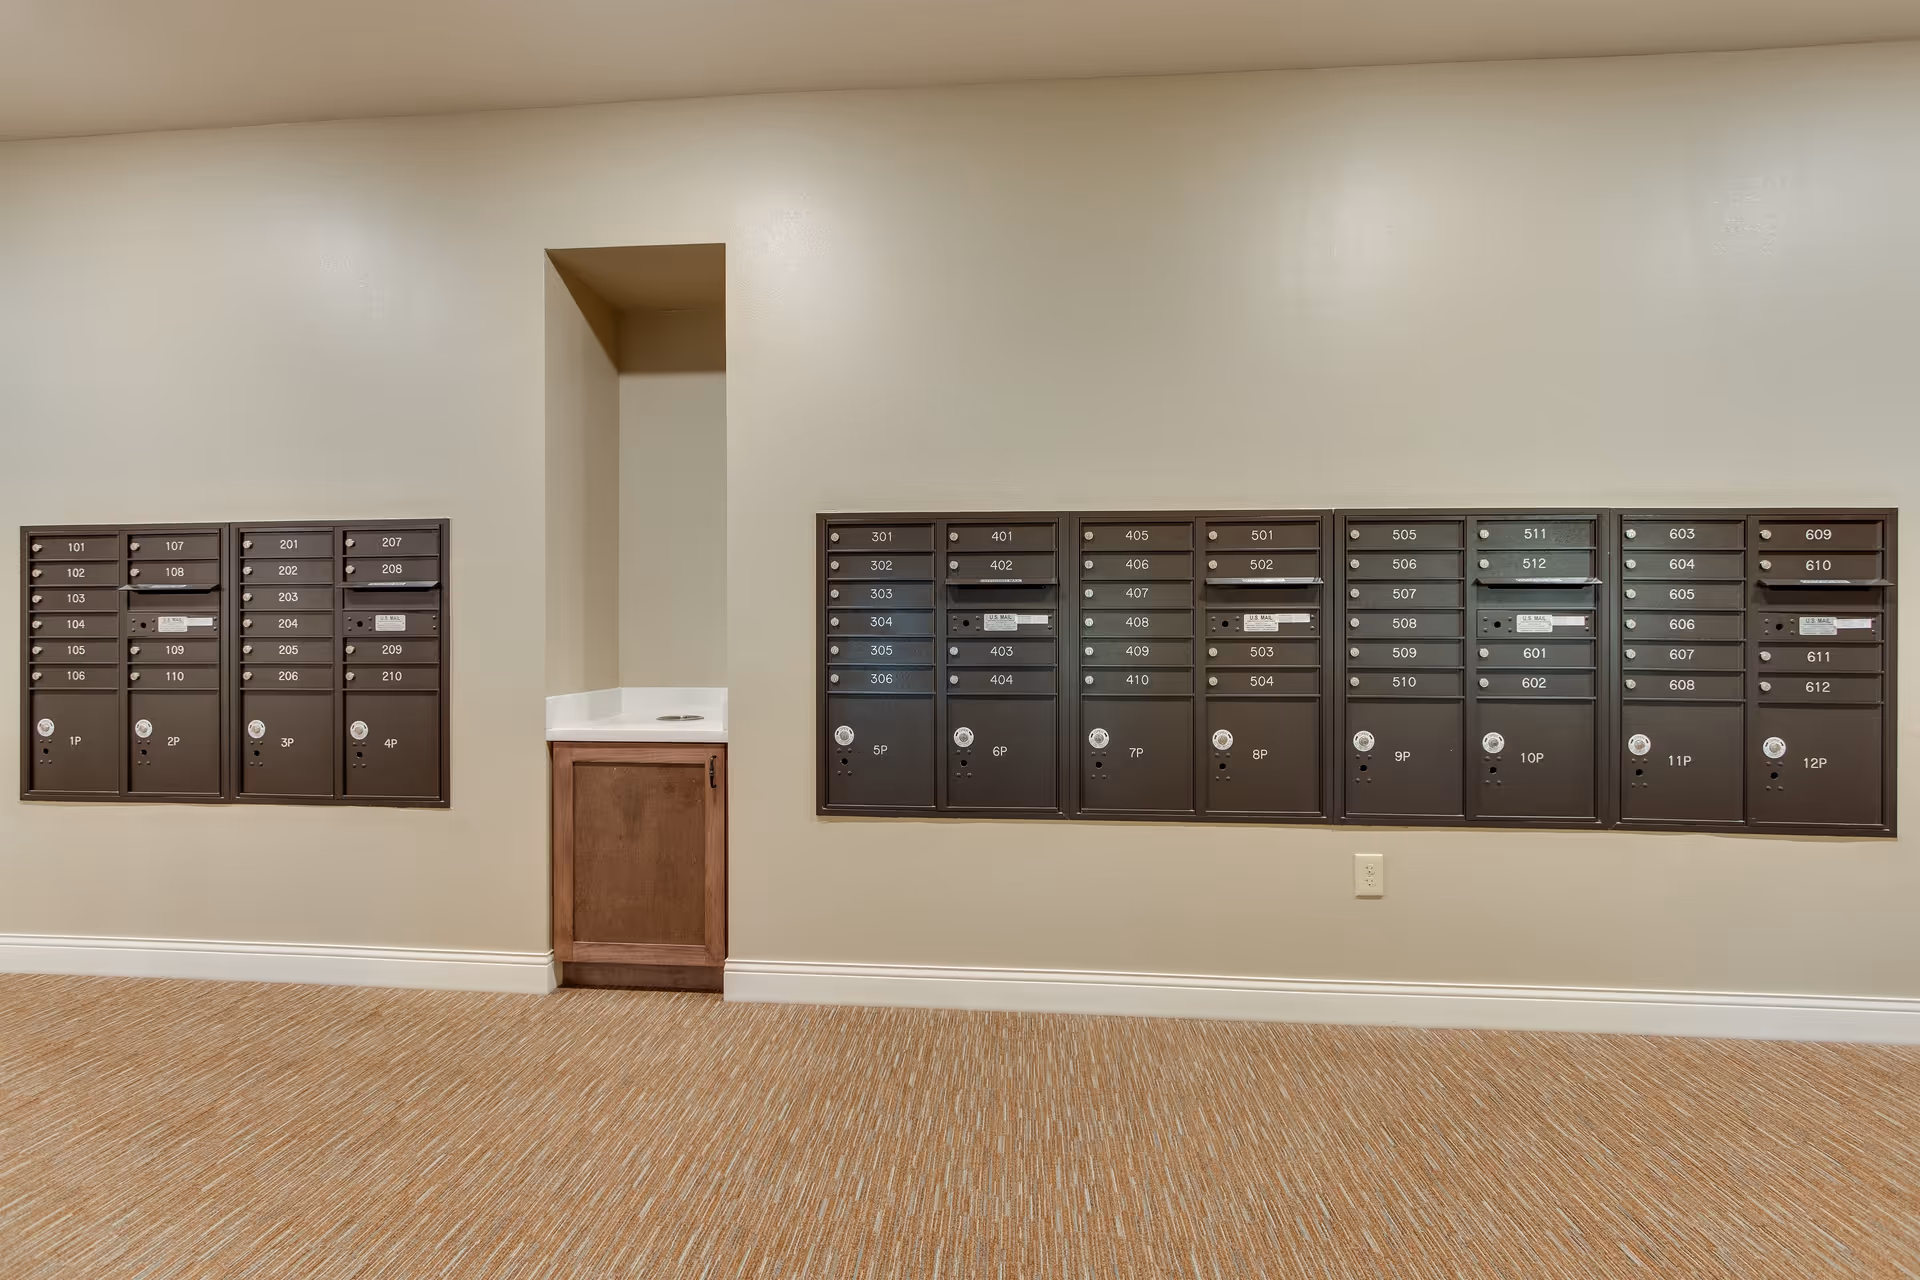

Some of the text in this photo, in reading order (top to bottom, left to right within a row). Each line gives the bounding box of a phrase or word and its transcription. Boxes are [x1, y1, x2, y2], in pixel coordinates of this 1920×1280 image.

[871, 531, 892, 542] 301
[991, 530, 1012, 542] 401
[1125, 530, 1149, 541] 405
[1251, 529, 1273, 541] 501
[1392, 529, 1417, 541] 505
[1524, 528, 1546, 540] 511
[1669, 528, 1696, 540] 603
[1805, 528, 1832, 541] 609
[68, 542, 85, 553] 101
[165, 541, 184, 551] 107
[279, 539, 298, 550] 201
[382, 537, 402, 548] 207
[381, 563, 403, 574] 208
[870, 559, 893, 571] 302
[989, 559, 1013, 571] 402
[1125, 558, 1149, 570] 406
[1249, 559, 1274, 571] 502
[1392, 558, 1417, 570] 506
[1522, 557, 1547, 569] 512
[1669, 558, 1695, 570] 604
[1805, 559, 1832, 571] 610
[67, 567, 86, 578] 102
[165, 567, 185, 577] 108
[278, 565, 298, 576] 202
[67, 593, 86, 604] 103
[278, 591, 299, 602] 203
[870, 588, 893, 599] 303
[1125, 587, 1149, 599] 407
[1392, 588, 1417, 600] 507
[1669, 588, 1695, 600] 605
[67, 619, 86, 630] 104
[278, 618, 299, 629] 204
[870, 616, 893, 628] 304
[1125, 616, 1150, 628] 408
[1392, 617, 1417, 629] 508
[1669, 618, 1695, 630] 606
[67, 645, 86, 655] 105
[165, 645, 185, 655] 109
[278, 644, 299, 655] 205
[381, 644, 403, 655] 209
[870, 644, 893, 656] 305
[990, 645, 1014, 657] 403
[1125, 645, 1150, 657] 409
[1250, 646, 1274, 658] 503
[1392, 647, 1417, 659] 509
[1523, 647, 1546, 659] 601
[1669, 648, 1695, 660] 607
[1806, 651, 1830, 663] 611
[67, 670, 86, 681] 106
[166, 671, 185, 682] 110
[278, 670, 299, 681] 206
[382, 671, 403, 682] 210
[870, 673, 893, 684] 306
[989, 674, 1013, 685] 404
[1125, 674, 1149, 686] 410
[1249, 675, 1274, 687] 504
[1392, 676, 1417, 688] 510
[1521, 677, 1547, 689] 602
[1669, 679, 1695, 691] 608
[1805, 681, 1831, 693] 612
[69, 735, 82, 746] 1P
[167, 736, 180, 747] 2P
[280, 737, 295, 748] 3P
[383, 738, 398, 749] 4P
[873, 744, 888, 756] 5P
[992, 745, 1008, 757] 6P
[1128, 747, 1144, 758] 7P
[1252, 748, 1268, 760] 8P
[1394, 750, 1411, 762] 9P
[1520, 752, 1544, 764] 10P
[1668, 755, 1692, 767] 11P
[1803, 757, 1828, 769] 12P
